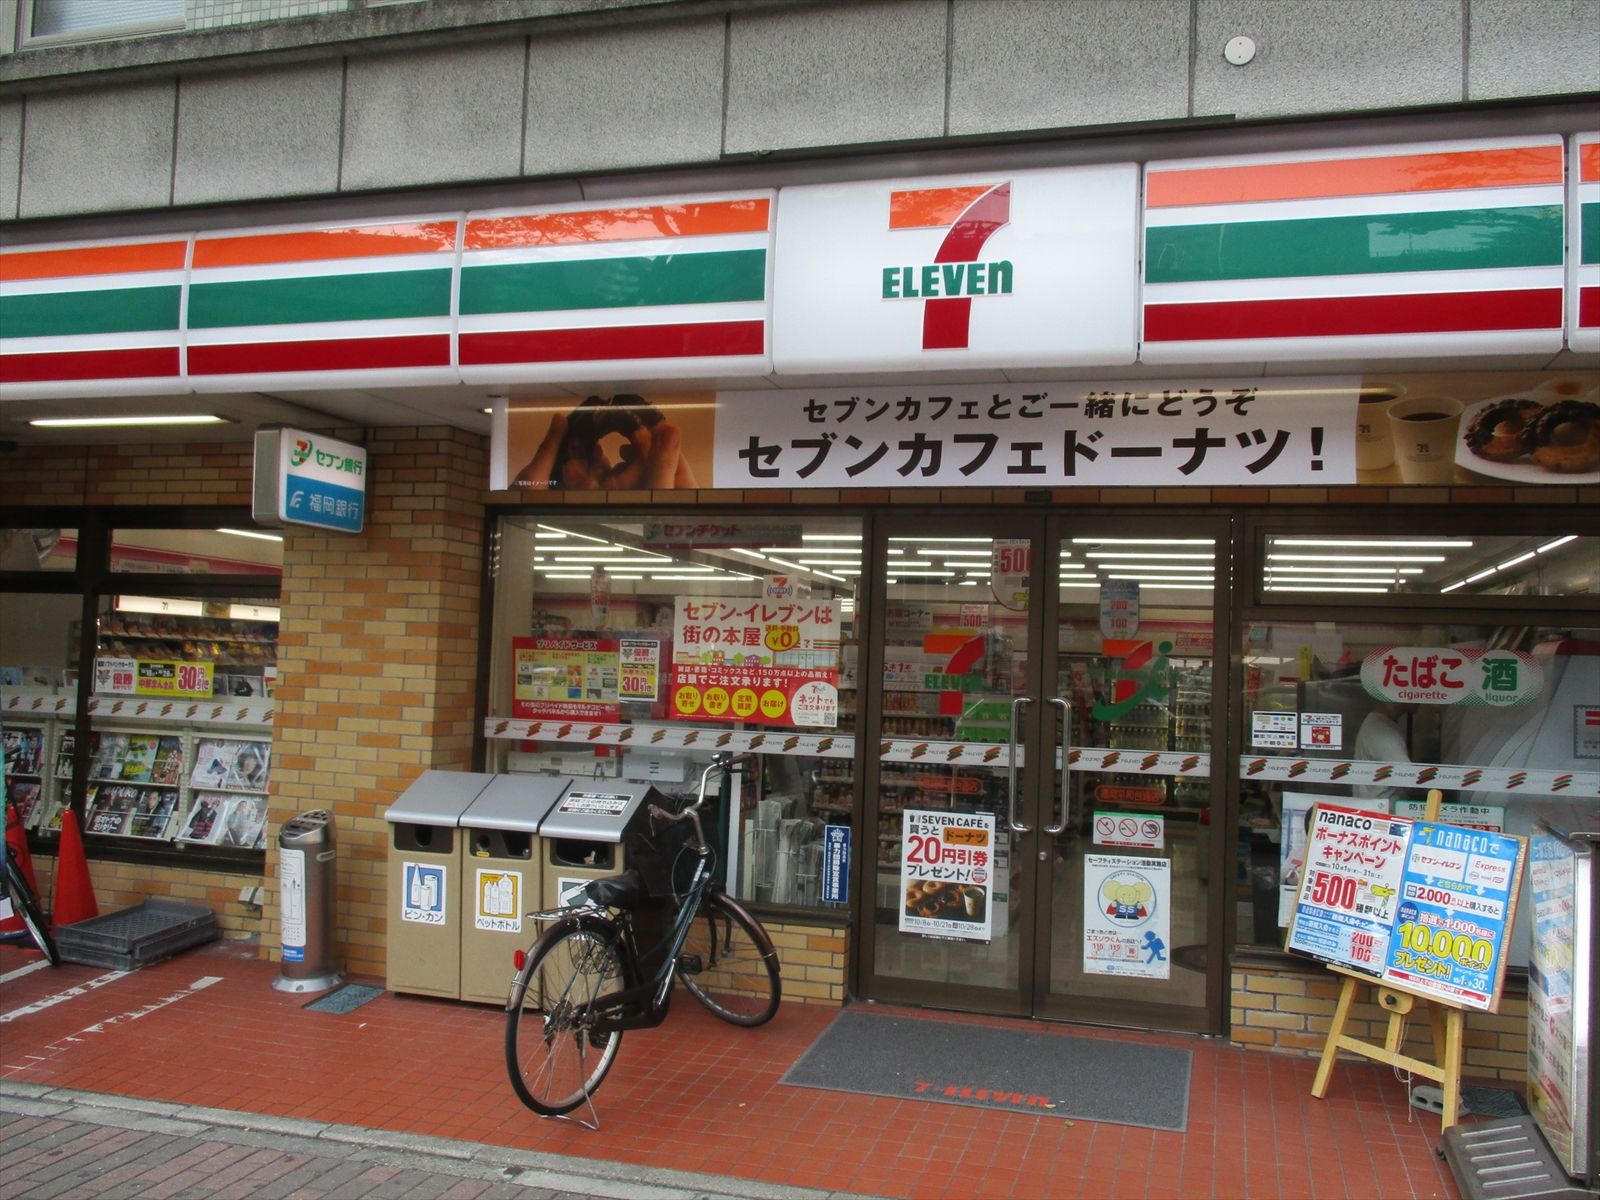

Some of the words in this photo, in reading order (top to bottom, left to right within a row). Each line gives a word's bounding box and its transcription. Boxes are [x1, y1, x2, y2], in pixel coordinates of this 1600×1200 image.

[888, 180, 1012, 350] 7
[803, 386, 1259, 424] セブンカフェとご一緒にどうぞ
[316, 449, 363, 476] セブン銀行
[309, 493, 360, 521] 福岡銀行
[664, 524, 742, 537] セブンチケット
[683, 603, 833, 624] セブン-イレブンは
[683, 625, 761, 647] 街の本屋
[178, 665, 197, 690] 30
[1383, 655, 1464, 690] たばこ
[1481, 658, 1518, 692] 酒
[622, 677, 639, 692] 30
[1398, 689, 1448, 701] cigarette
[1485, 692, 1519, 703] liquor
[909, 824, 940, 836] 買うと
[922, 815, 955, 826] SEVEN
[1319, 811, 1372, 830] nanaco
[946, 830, 986, 843] ドーナツ
[1315, 827, 1402, 855] ボーナスポイント
[1436, 830, 1500, 855] nanacoで
[907, 835, 989, 867] 20円引券
[1322, 845, 1386, 869] キャンペーン
[907, 865, 971, 881] プレゼント!
[1475, 861, 1507, 873] Express
[1311, 871, 1358, 911] 500
[404, 910, 444, 922] ビン・カン
[1119, 905, 1136, 914] SS
[1355, 903, 1390, 919] 種類以上
[477, 918, 520, 931] ペットボトル
[1398, 922, 1494, 966] 10,000
[1394, 951, 1452, 979] プレゼント!
[1459, 957, 1489, 971] ポイント
